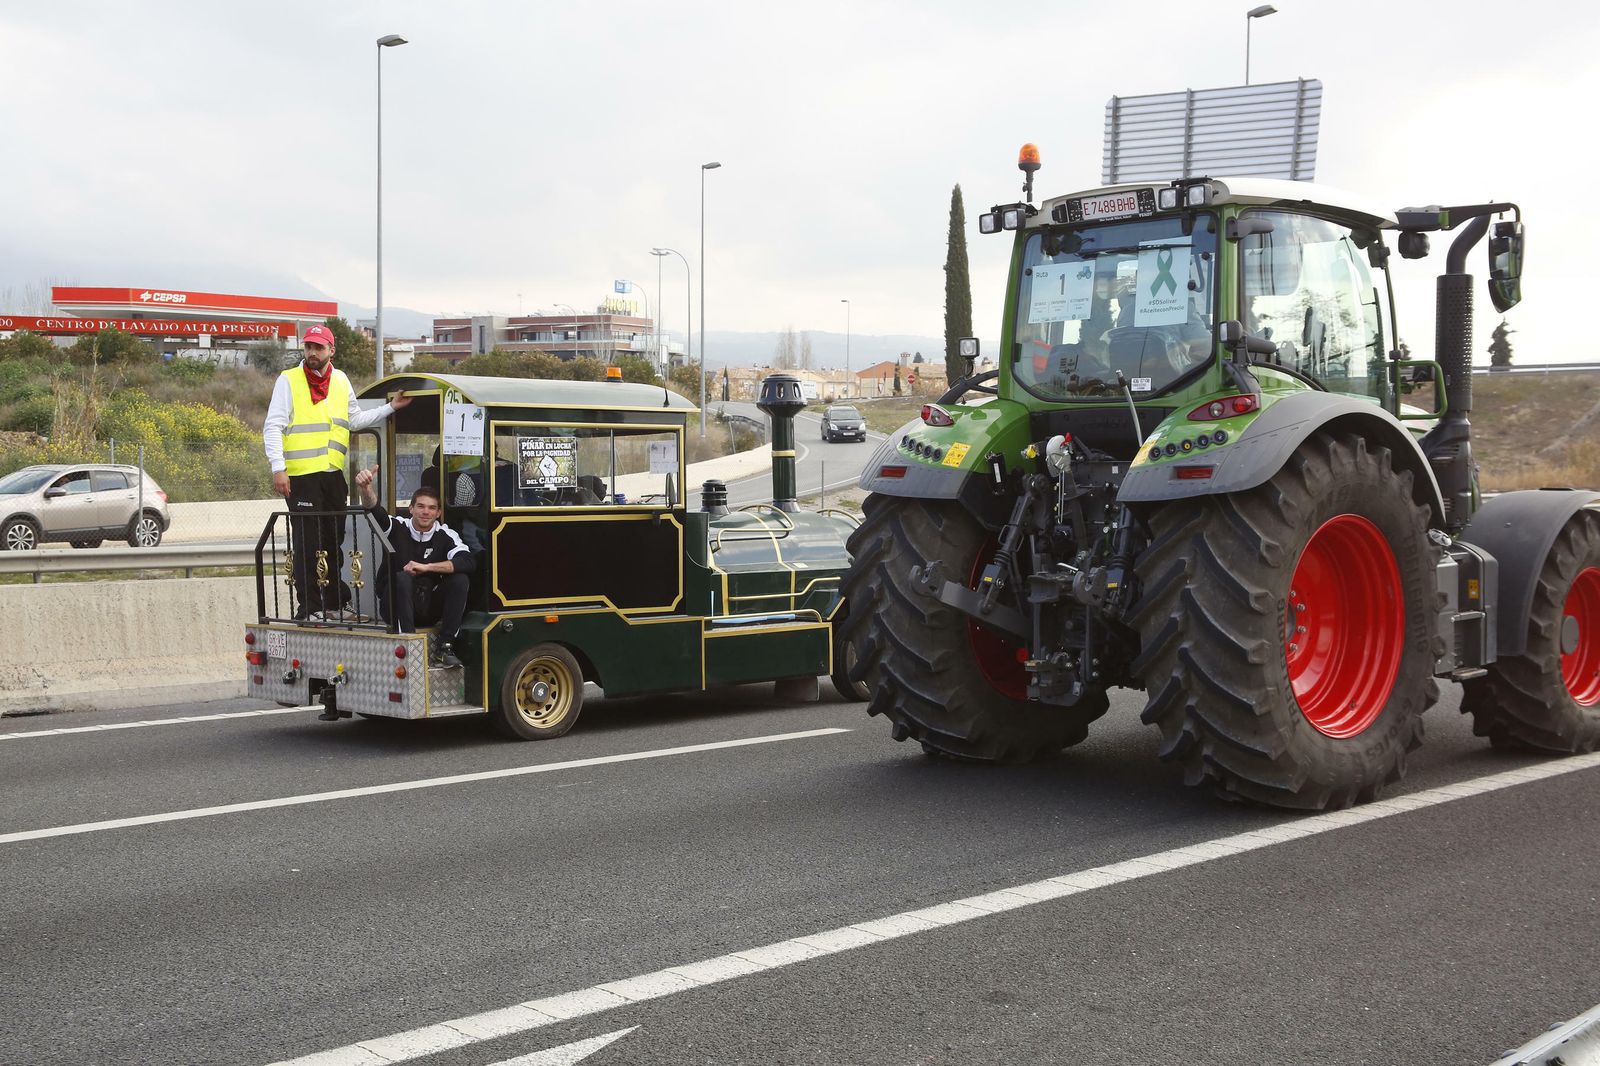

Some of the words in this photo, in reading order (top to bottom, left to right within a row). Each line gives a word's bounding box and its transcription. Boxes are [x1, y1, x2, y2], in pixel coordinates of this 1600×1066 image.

[1059, 273, 1066, 295] 1
[153, 292, 187, 303] CEPSA
[36, 319, 95, 329] CENTRO
[99, 320, 117, 329] DE
[121, 321, 179, 331] LAVADO
[183, 323, 218, 332] ALTA
[461, 413, 465, 432] 1
[539, 476, 569, 484] CAMPO
